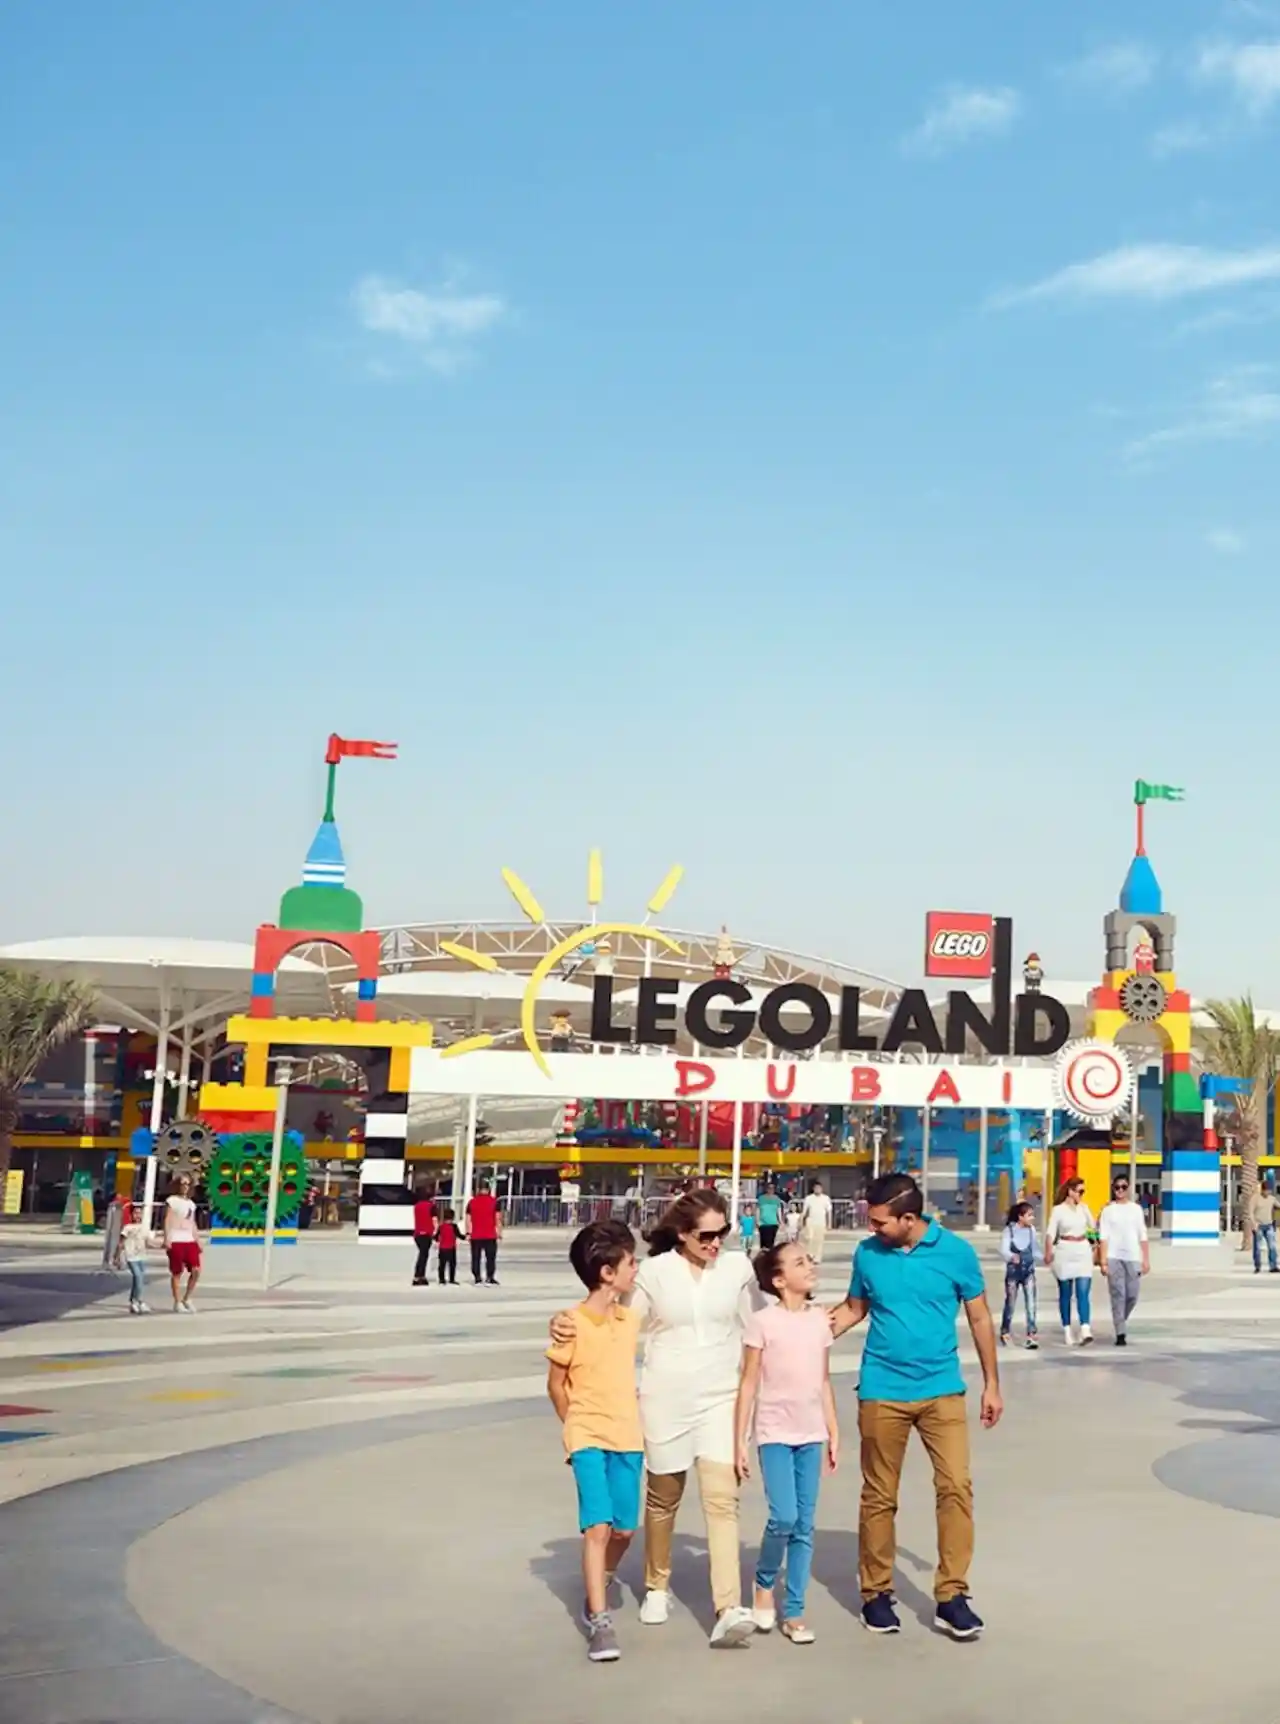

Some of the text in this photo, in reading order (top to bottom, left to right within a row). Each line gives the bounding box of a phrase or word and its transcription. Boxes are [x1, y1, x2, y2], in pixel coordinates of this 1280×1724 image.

[933, 933, 988, 957] LEGO
[590, 917, 1071, 1057] LEGOLAND
[675, 1061, 1012, 1104] DUBAI
